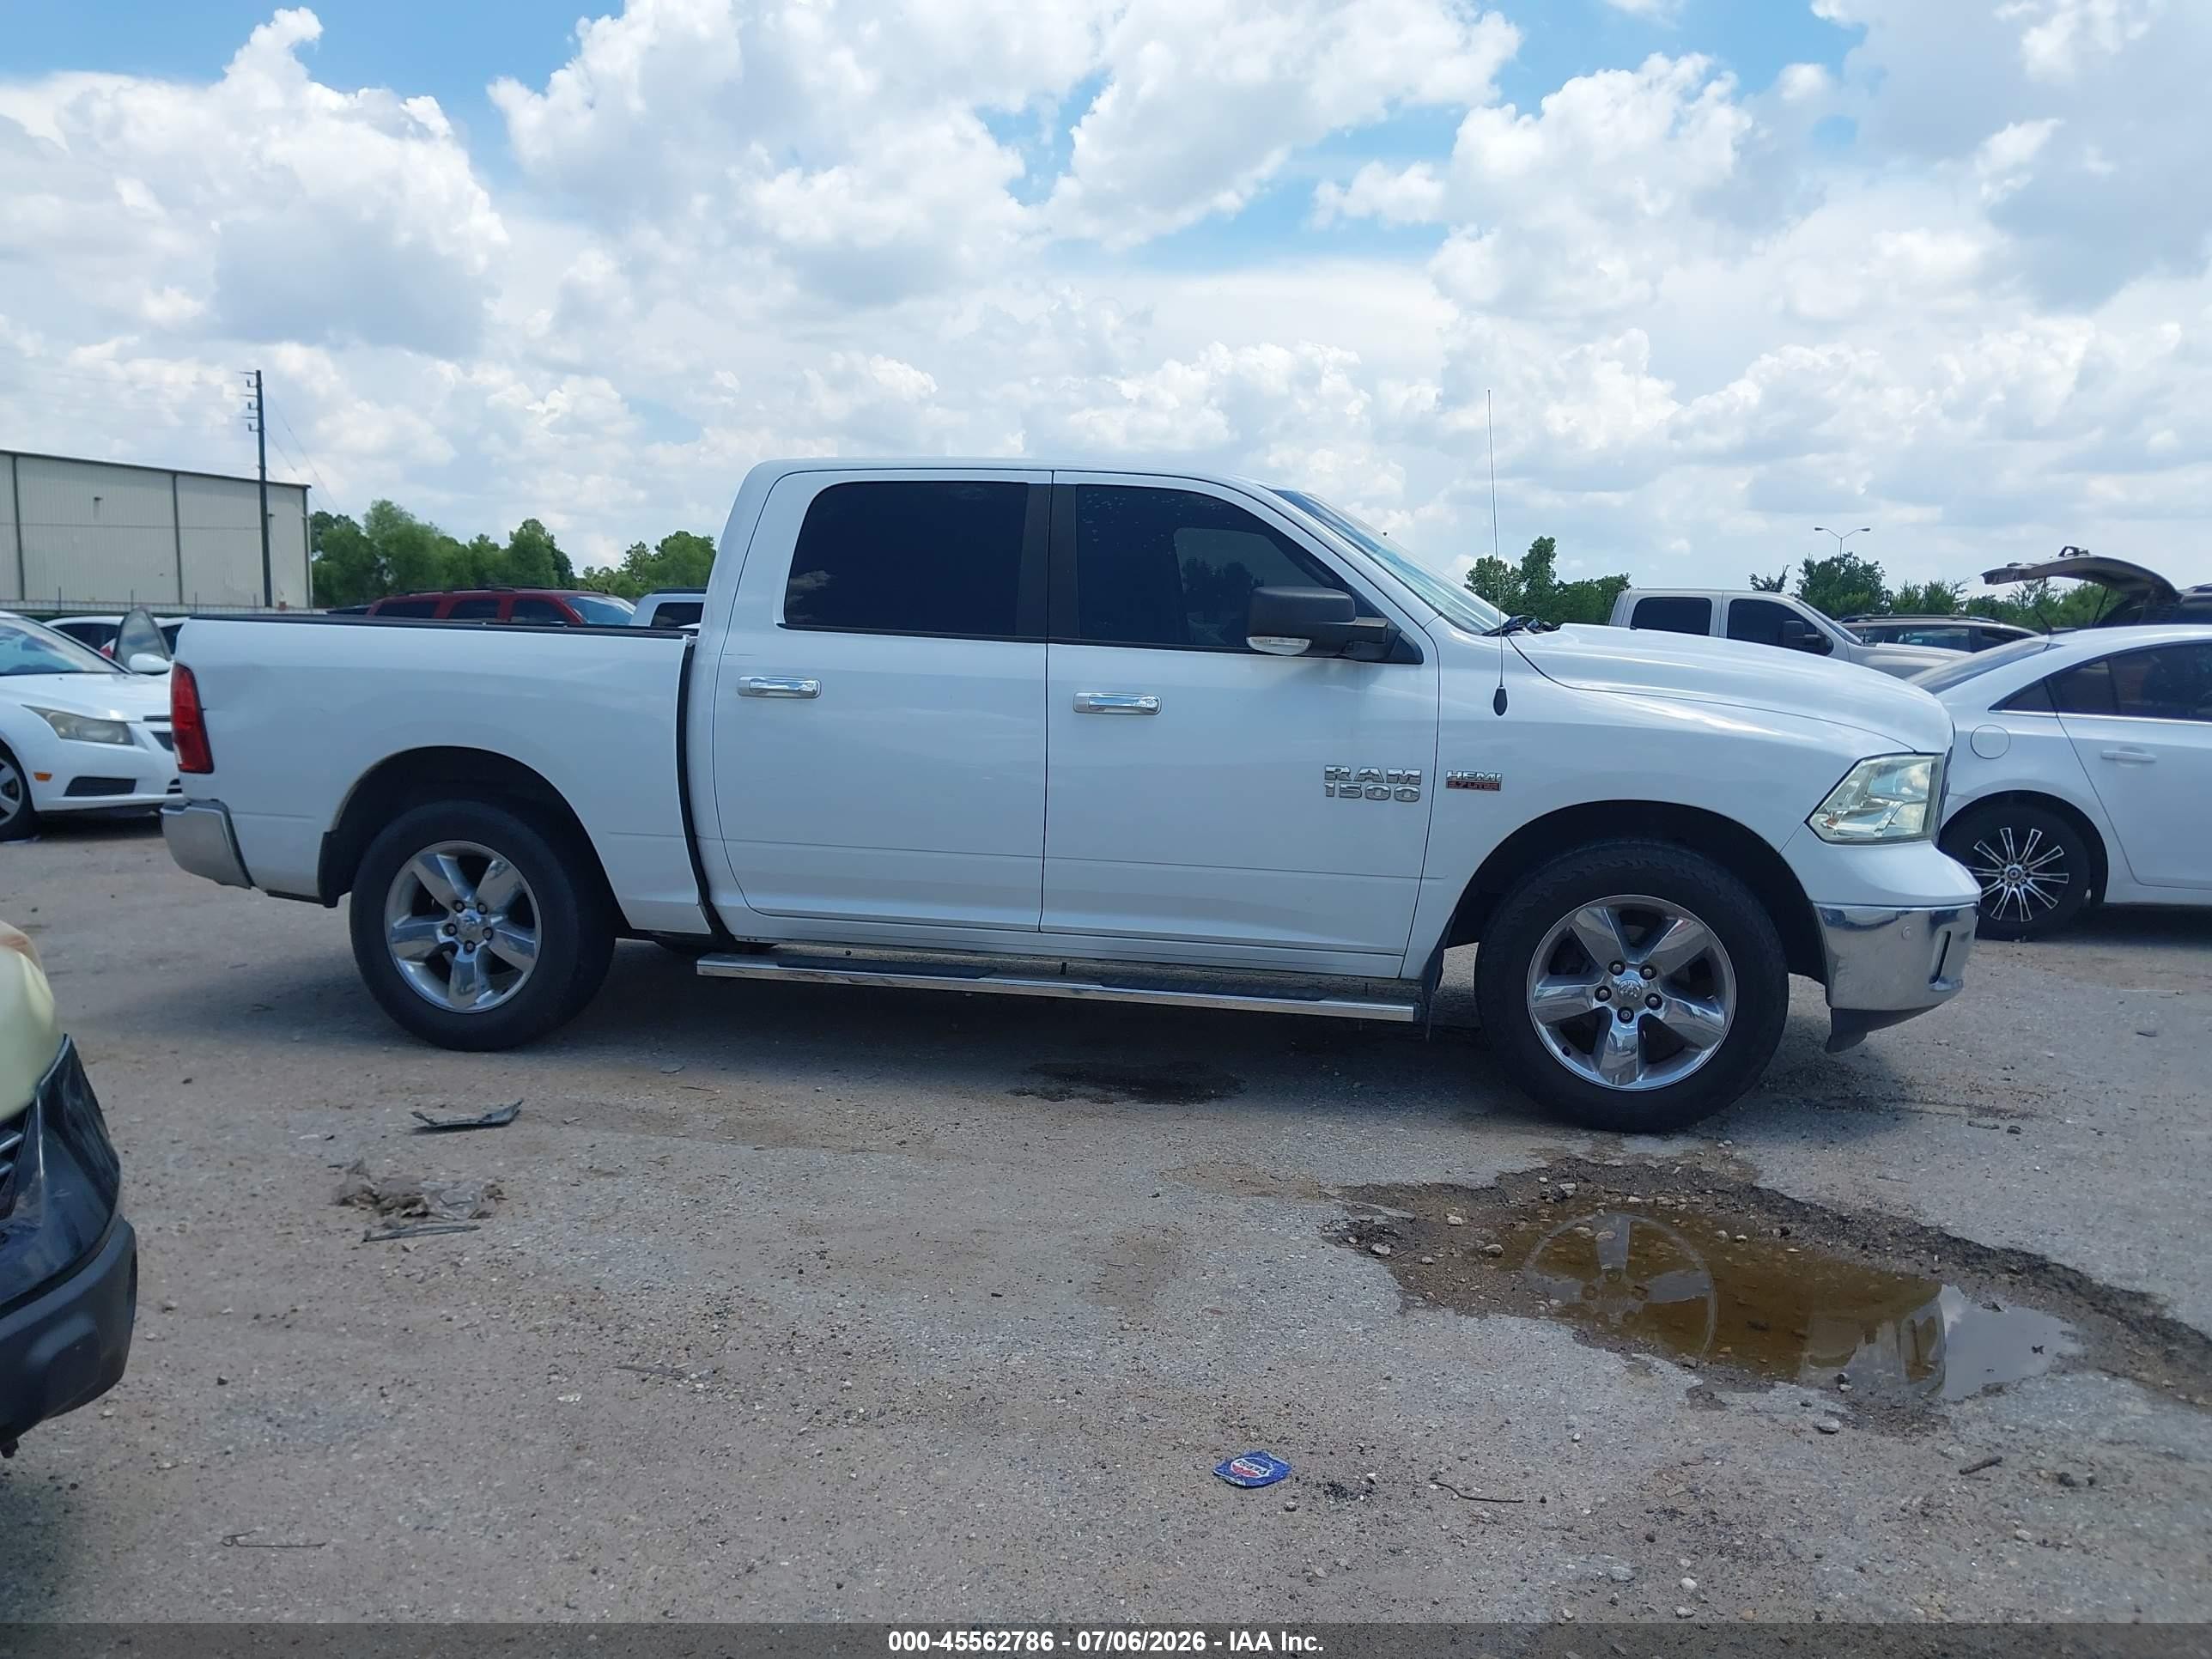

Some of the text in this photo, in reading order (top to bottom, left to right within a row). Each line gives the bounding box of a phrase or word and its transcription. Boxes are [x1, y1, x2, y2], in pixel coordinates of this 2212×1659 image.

[1324, 764, 1422, 785] RAM
[1446, 770, 1501, 781] HEMI
[1323, 782, 1421, 802] 1500
